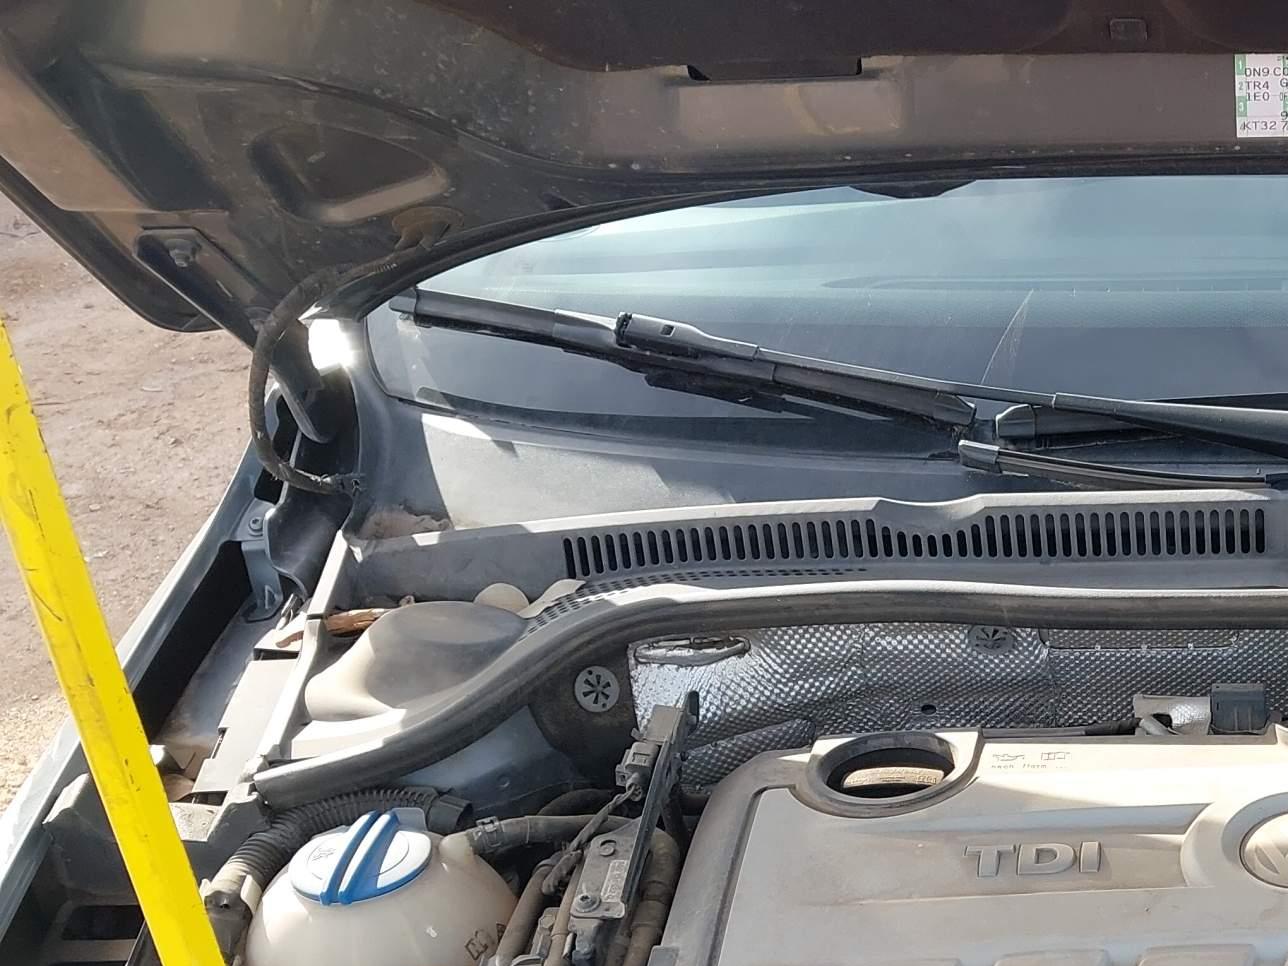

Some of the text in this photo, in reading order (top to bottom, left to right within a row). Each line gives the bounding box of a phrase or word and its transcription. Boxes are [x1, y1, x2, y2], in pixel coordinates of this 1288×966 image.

[1245, 80, 1270, 90] TR4
[1247, 91, 1270, 102] 1E0
[963, 840, 1102, 879] TDI
